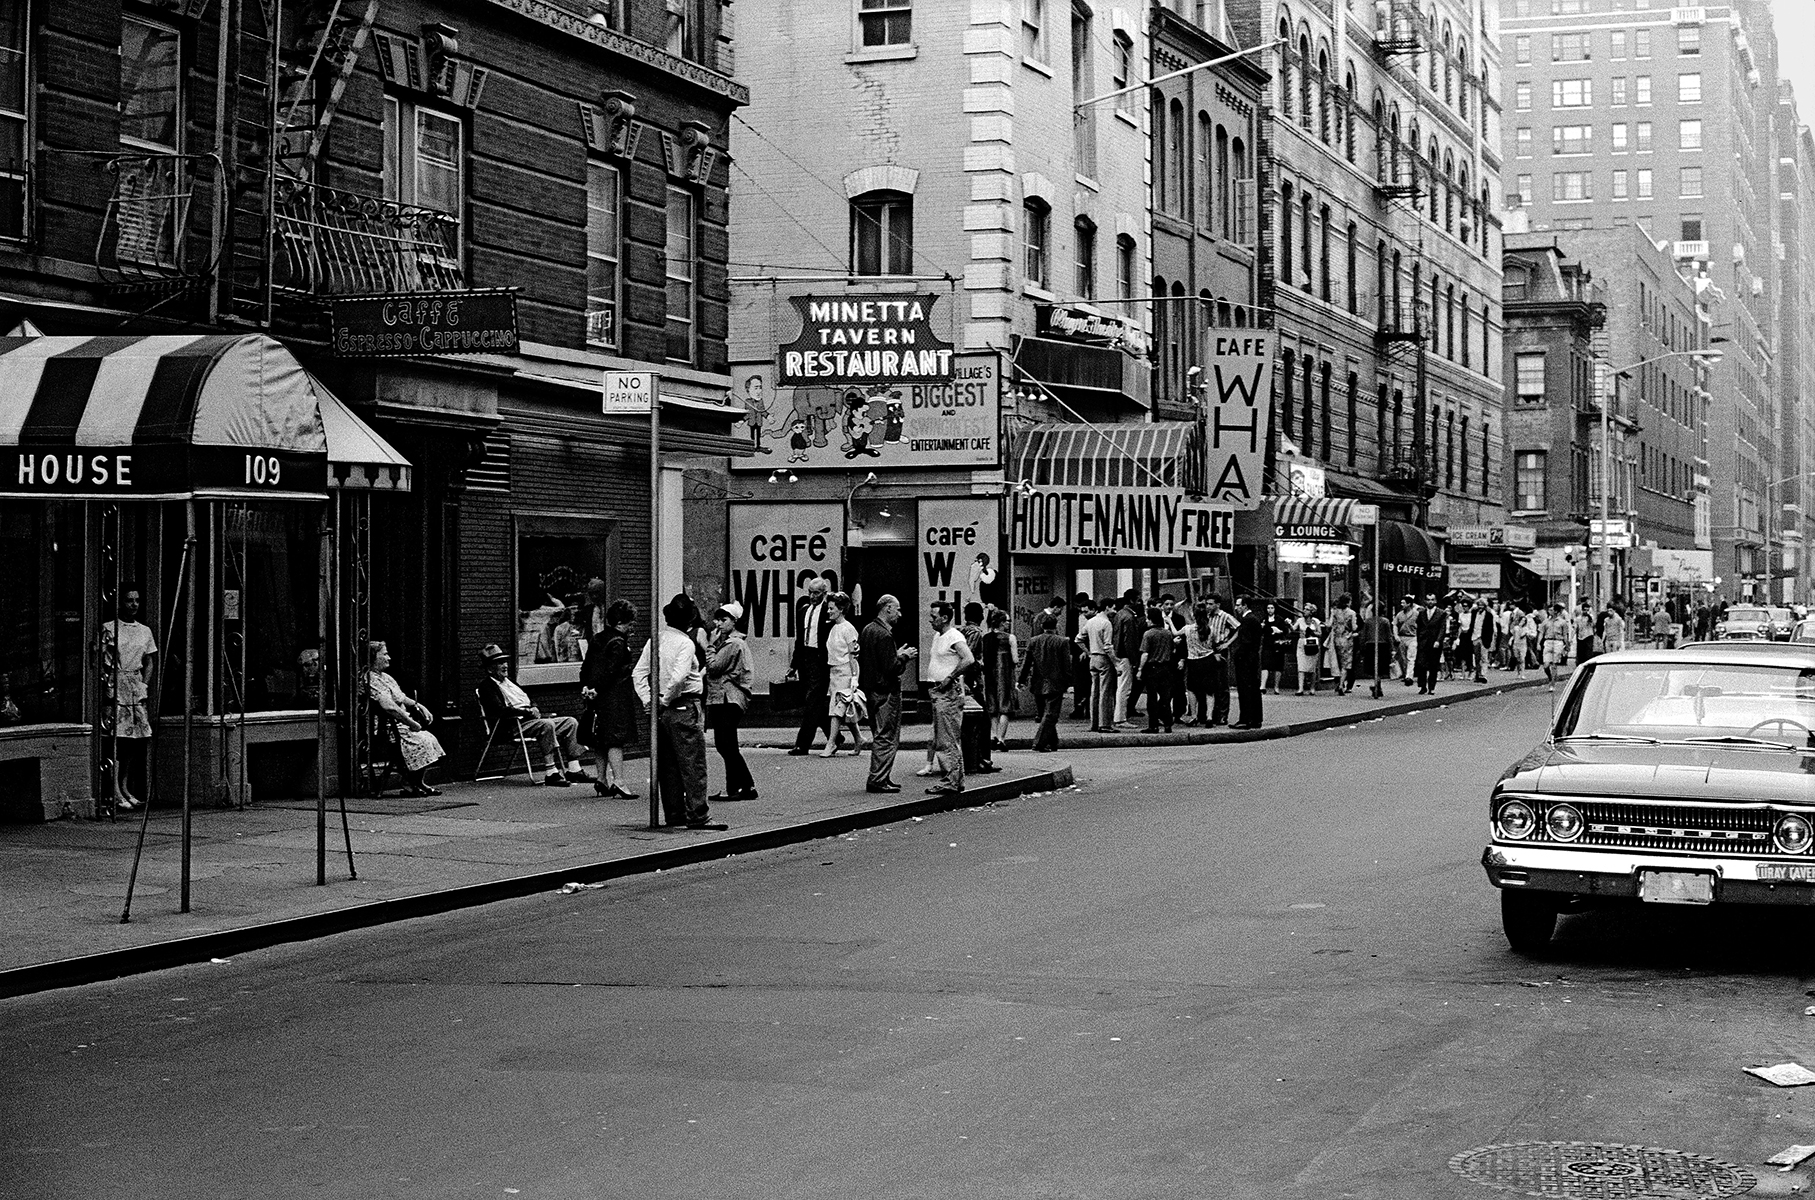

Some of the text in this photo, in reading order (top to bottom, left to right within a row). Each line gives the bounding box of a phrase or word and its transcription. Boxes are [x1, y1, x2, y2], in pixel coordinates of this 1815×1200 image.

[810, 301, 924, 322] MINETTA
[818, 328, 915, 344] TAVERN
[1216, 338, 1265, 356] CAFE
[785, 350, 953, 377] RESTAURANT
[618, 377, 641, 389] NO
[609, 392, 649, 403] PARKING
[912, 382, 988, 408] BIGGEST
[911, 438, 970, 451] ENTERTAINMENT
[18, 454, 132, 485] HOUSE
[246, 454, 281, 485] 109
[1011, 491, 1182, 554] HOOTENANNY
[1181, 509, 1233, 550] FREE
[1290, 526, 1336, 537] LOUNGE
[1072, 547, 1118, 555] TONITE
[1383, 562, 1395, 572] 119
[1396, 564, 1425, 576] CAFFE
[1015, 576, 1050, 595] FREE
[1756, 866, 1787, 879] LURAY
